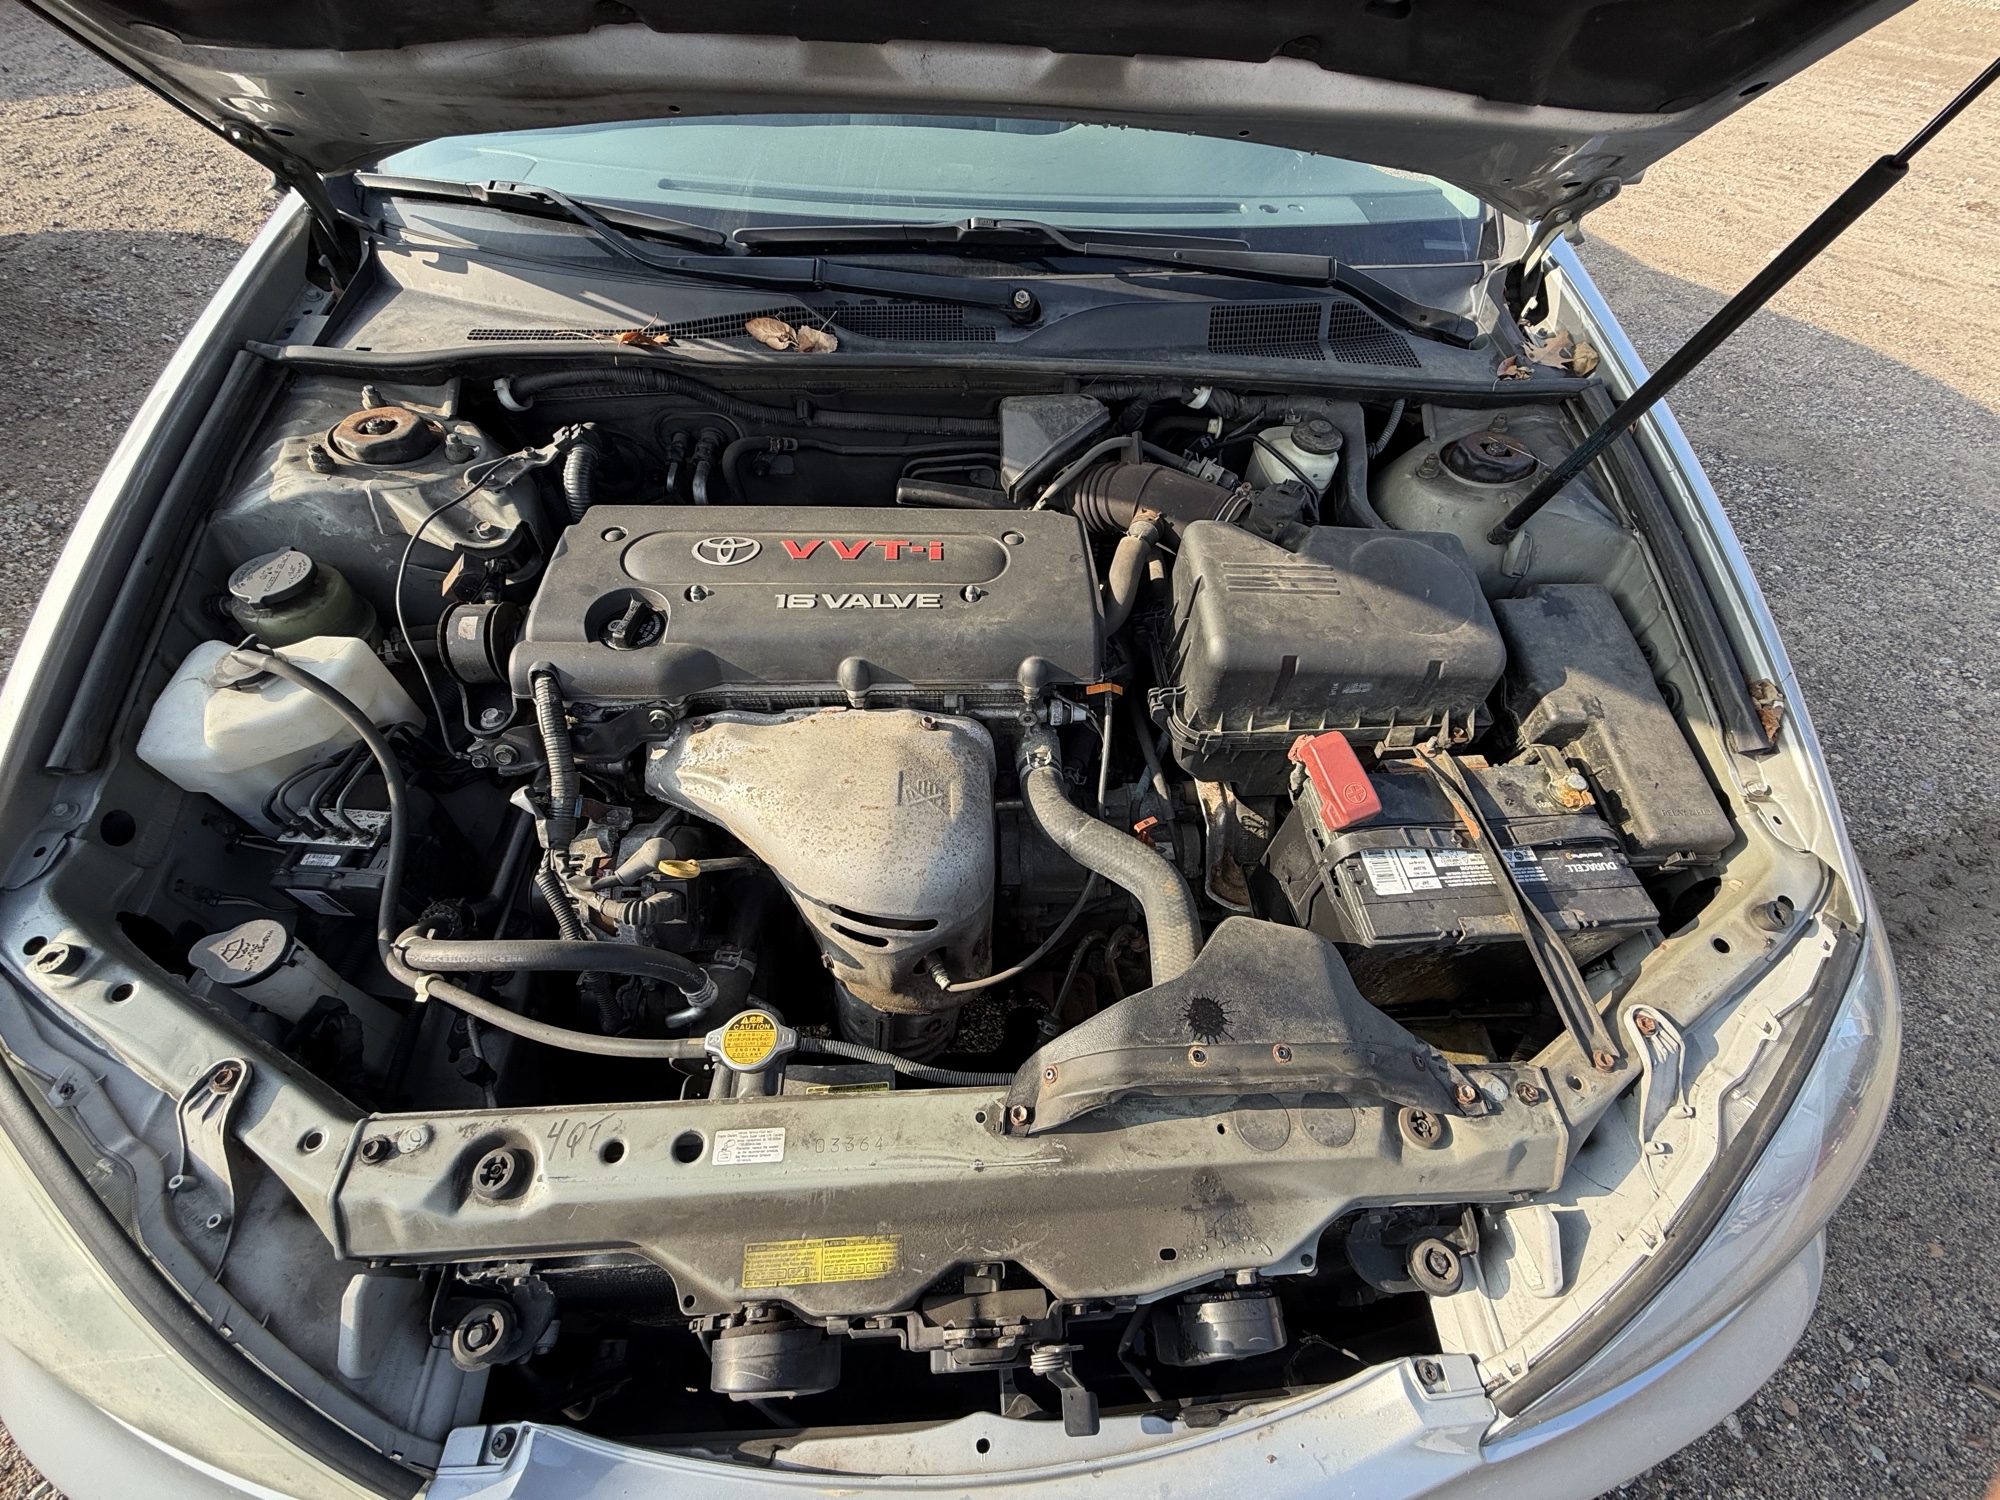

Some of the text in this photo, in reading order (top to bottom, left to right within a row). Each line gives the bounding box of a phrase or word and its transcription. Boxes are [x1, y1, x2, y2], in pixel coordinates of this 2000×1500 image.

[781, 539, 944, 561] VVT-i
[776, 593, 943, 609] 16 VALVE
[1661, 809, 1687, 817] RELAY
[1565, 861, 1618, 873] DURACELL
[733, 1023, 771, 1031] CAUTION
[815, 1137, 885, 1154] 03364
